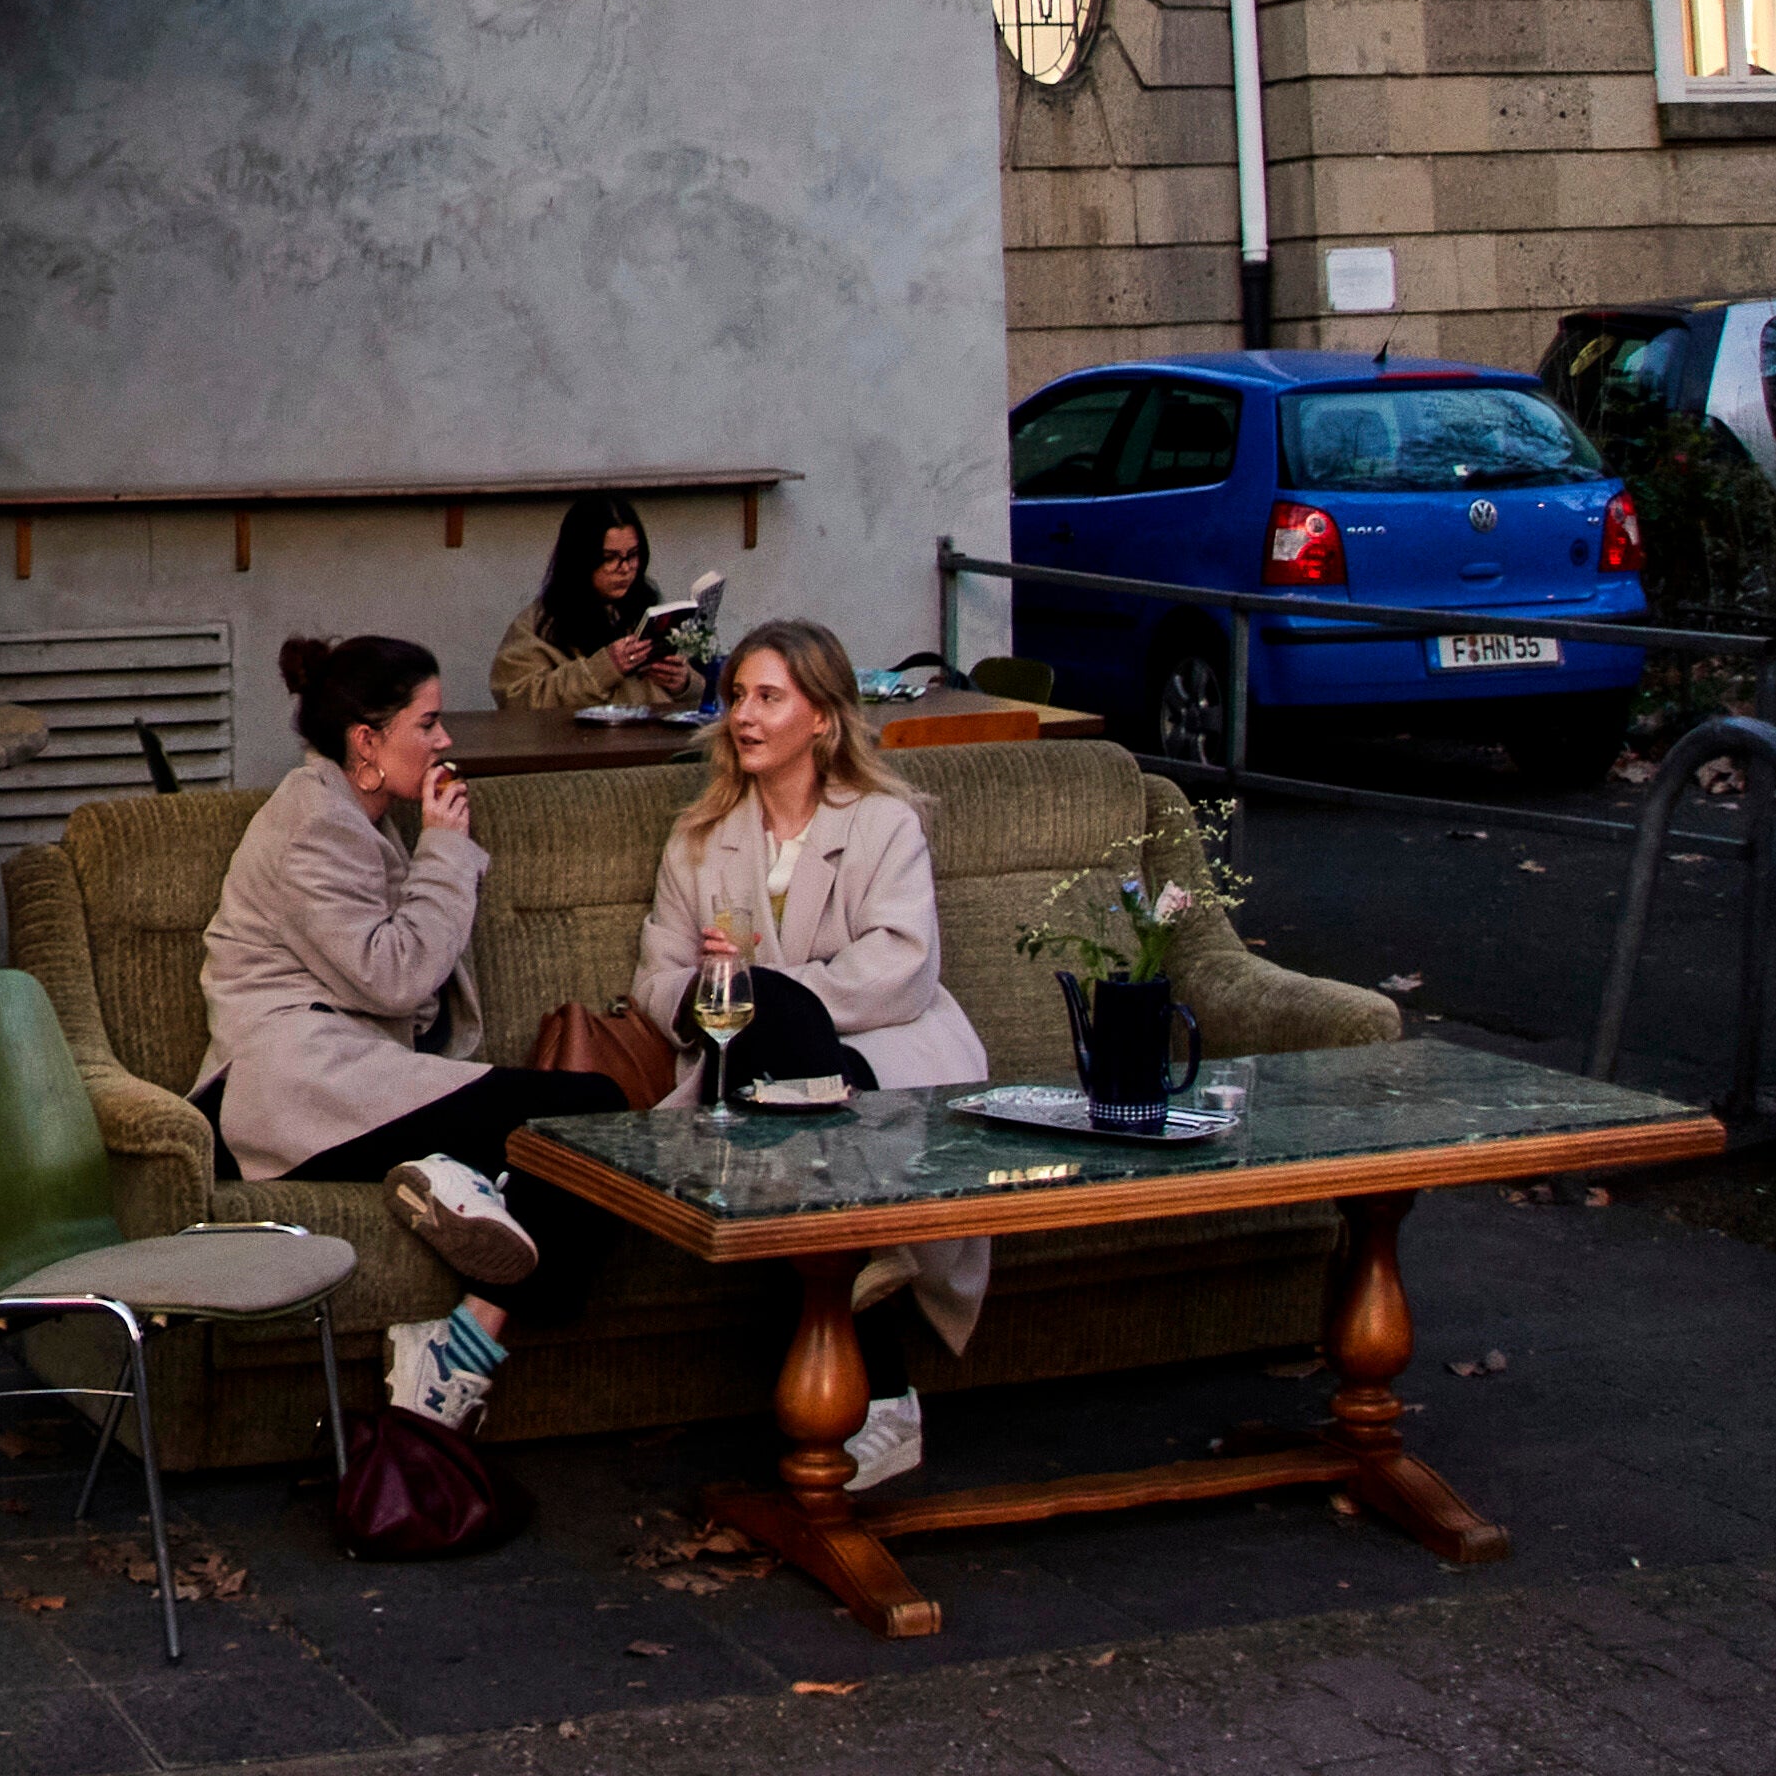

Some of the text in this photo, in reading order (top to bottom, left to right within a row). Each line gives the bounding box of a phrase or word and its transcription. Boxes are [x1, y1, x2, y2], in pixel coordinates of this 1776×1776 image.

[1452, 635, 1541, 663] F HN 55
